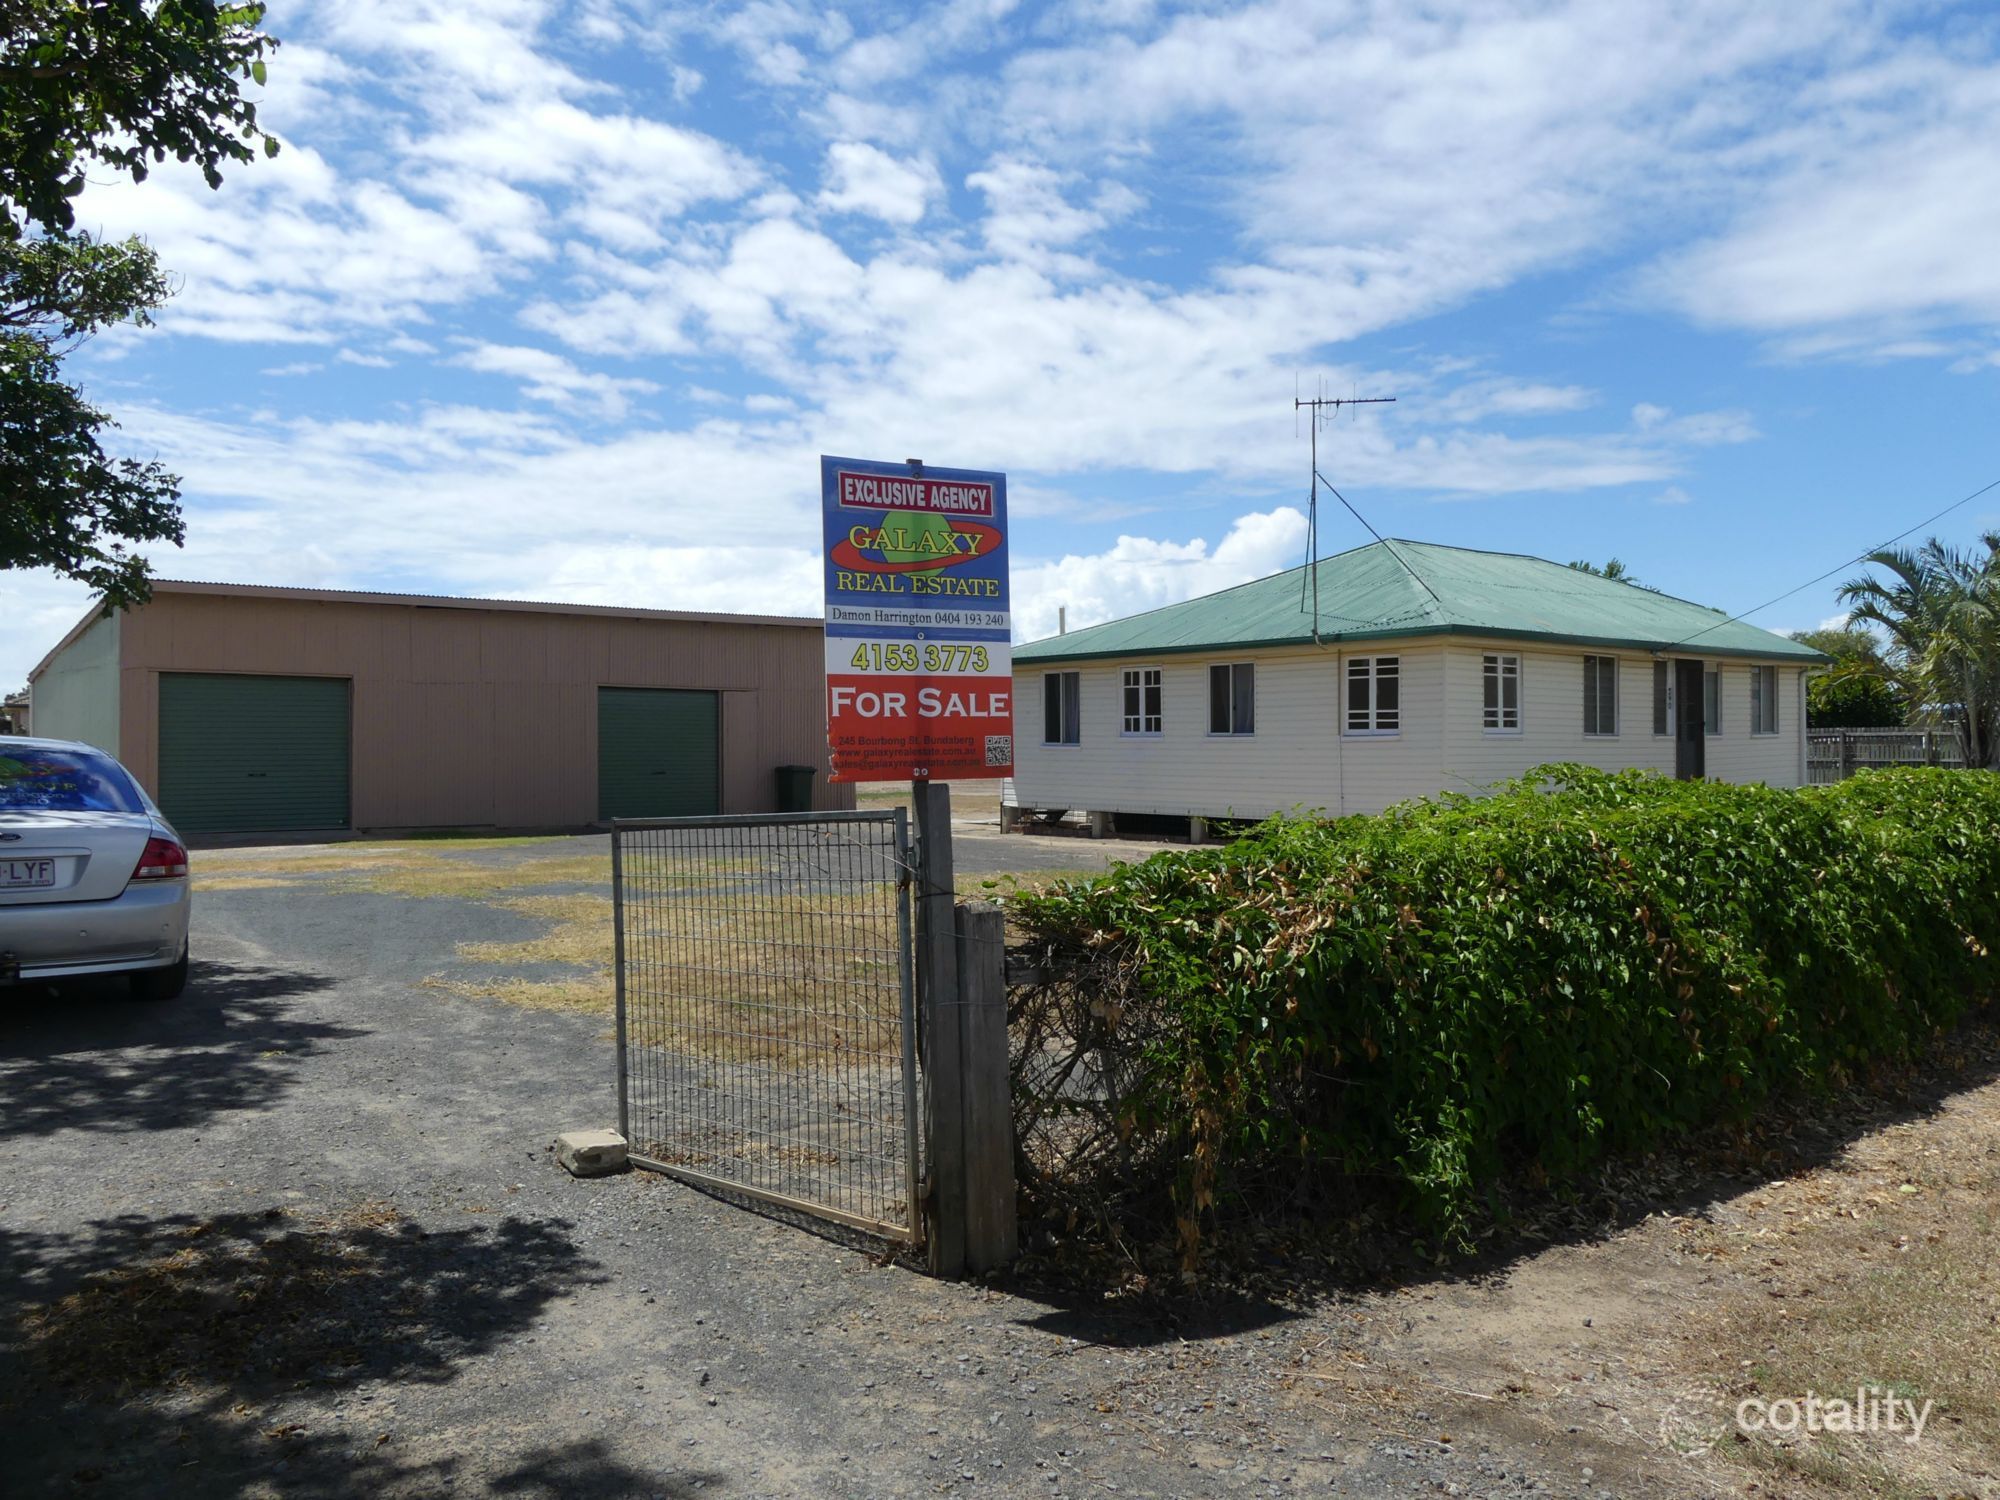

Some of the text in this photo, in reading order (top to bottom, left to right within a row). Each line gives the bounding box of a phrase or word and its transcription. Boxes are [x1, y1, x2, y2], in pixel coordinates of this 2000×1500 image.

[845, 478, 987, 511] EXCLUSIVE AGENCY
[849, 525, 983, 555] GALAXY
[836, 571, 999, 597] REAL ESTATE
[832, 608, 1004, 629] Damon Harrington 0404 193 240
[851, 643, 989, 672] 4153 3773
[831, 686, 1009, 718] FOR SALE
[923, 736, 975, 746] Bundaberg
